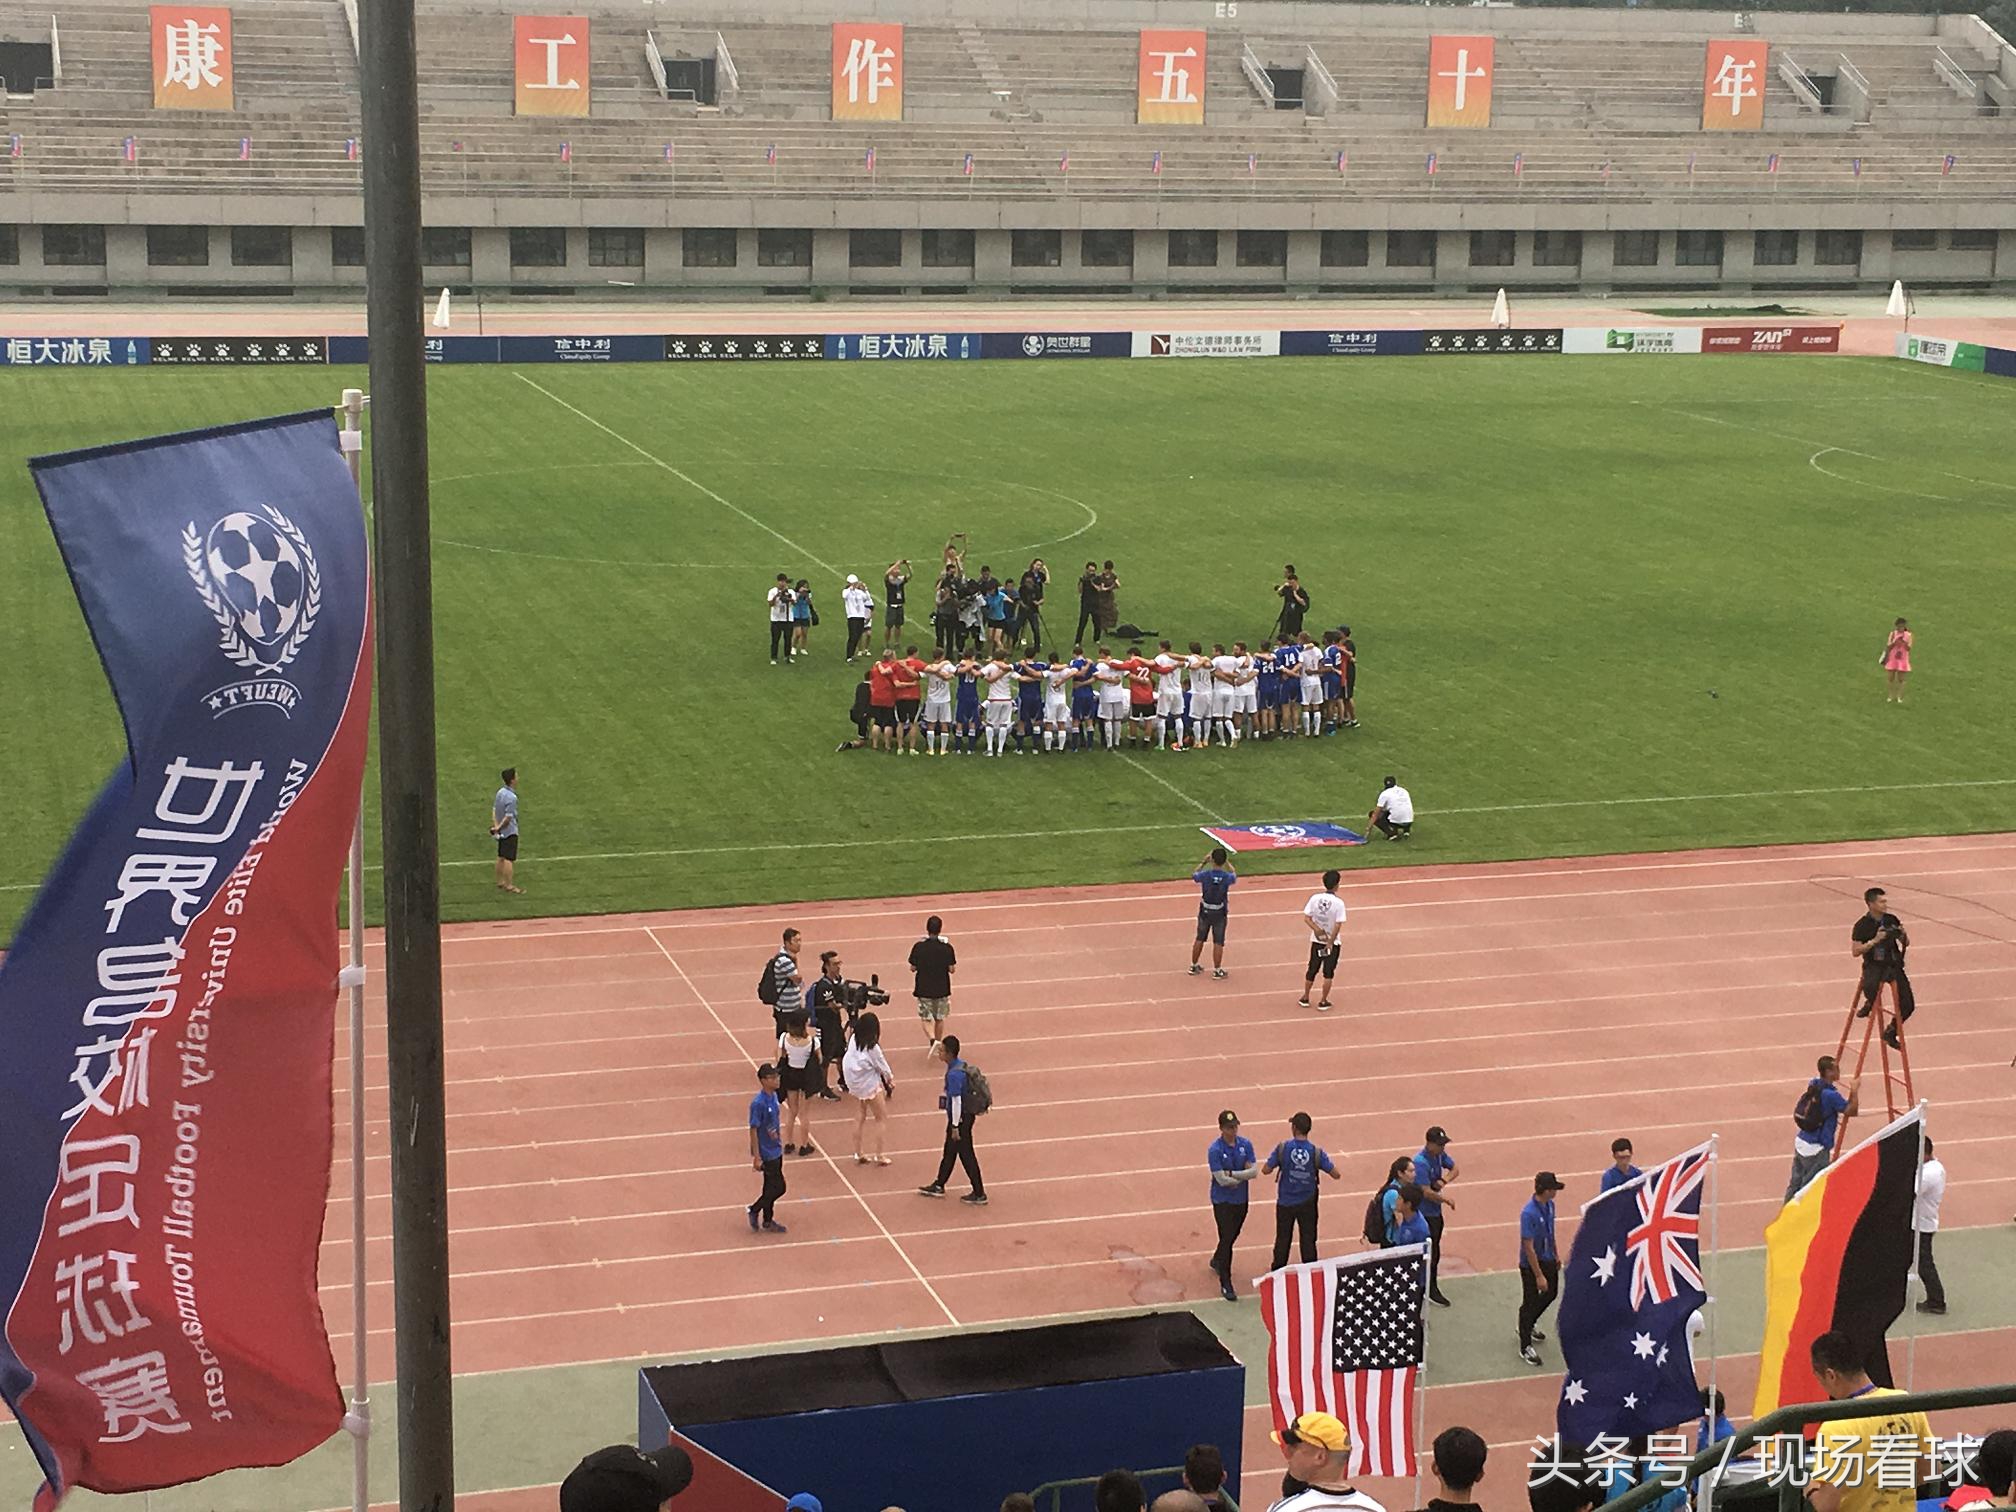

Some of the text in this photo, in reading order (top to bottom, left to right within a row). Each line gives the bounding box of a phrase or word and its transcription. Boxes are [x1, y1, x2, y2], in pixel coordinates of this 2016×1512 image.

[1215, 2, 1237, 17] E5
[162, 19, 1757, 117] 康 工 作 五 十 年
[555, 338, 611, 350] 信中利
[1327, 333, 1377, 344] 信中利
[7, 338, 112, 364] 恒大冰泉
[859, 334, 948, 359] 恒大冰泉
[1284, 652, 1296, 666] 14
[1136, 666, 1150, 680] 22
[1262, 661, 1274, 673] 24
